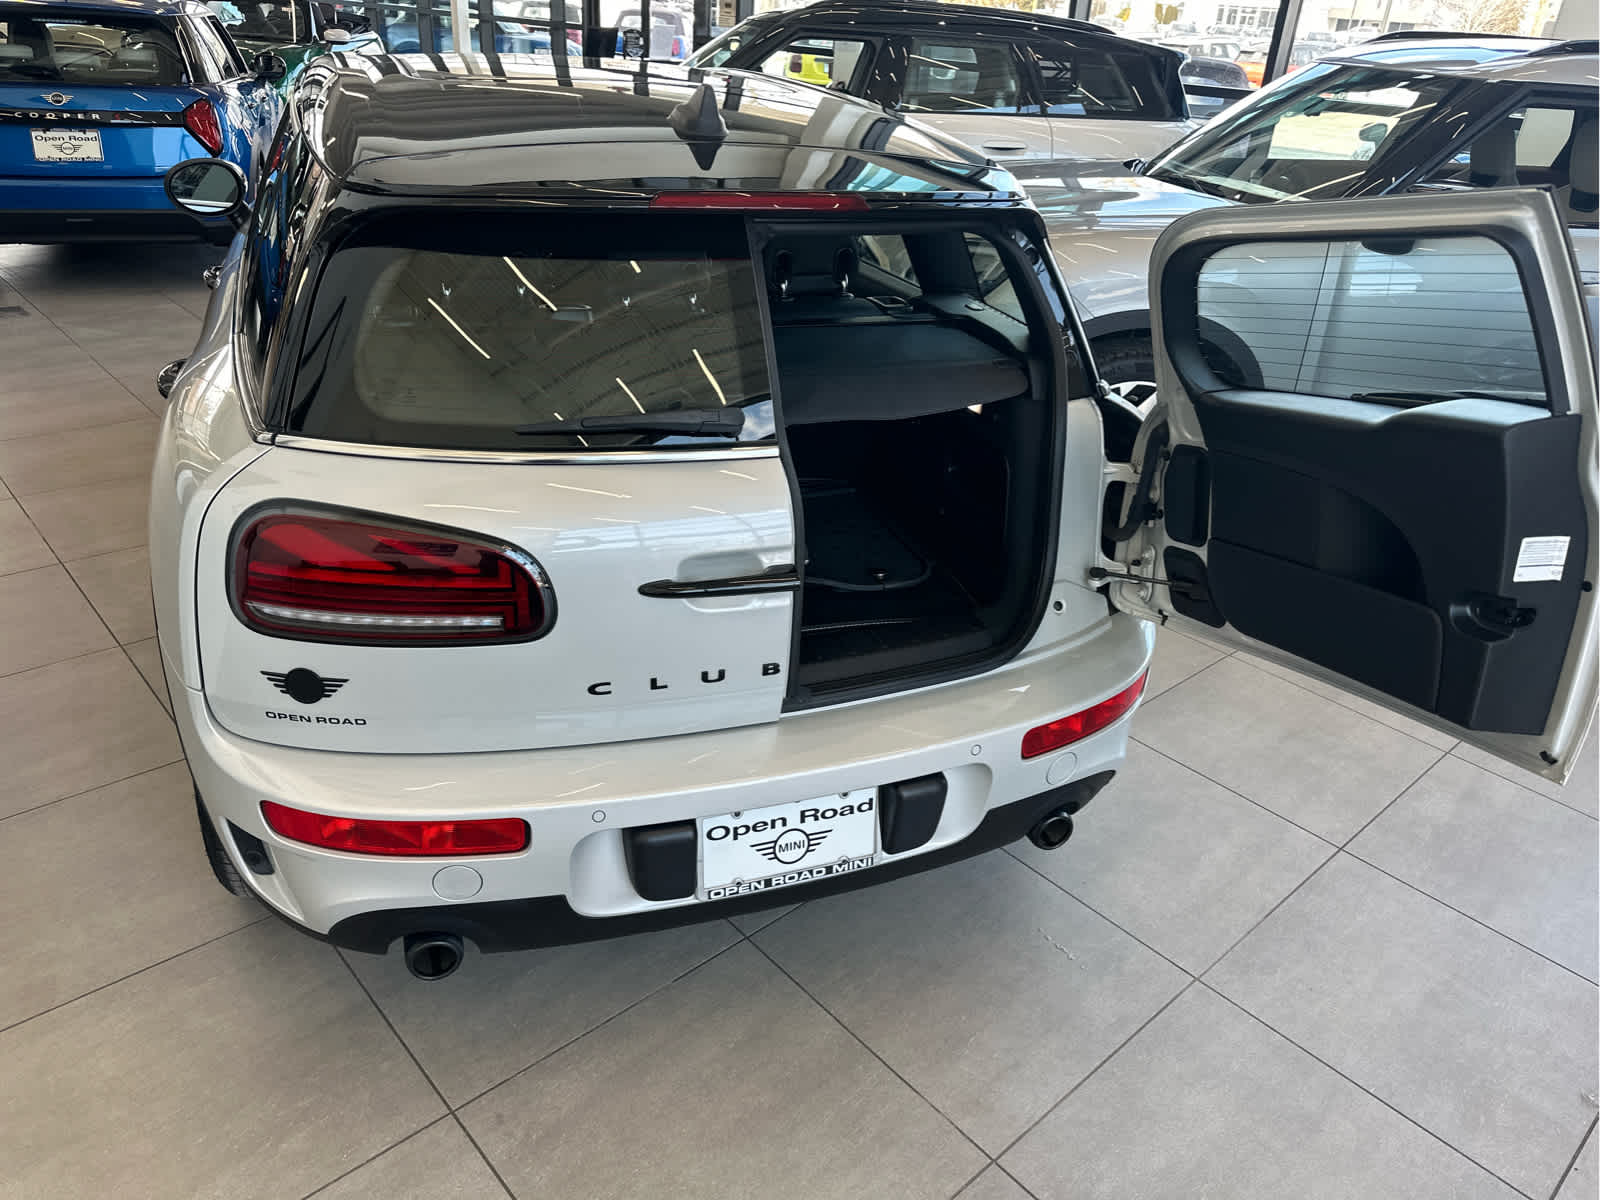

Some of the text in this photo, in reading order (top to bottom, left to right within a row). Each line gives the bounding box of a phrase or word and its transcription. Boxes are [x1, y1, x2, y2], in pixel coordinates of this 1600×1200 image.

[14, 111, 101, 120] COOPER
[34, 134, 65, 142] Open
[587, 662, 781, 696] CLUB
[265, 711, 367, 726] OPEN ROAD
[706, 798, 874, 841] Open Road
[778, 839, 806, 854] MINI
[709, 857, 873, 899] OPEN ROAD MINI
